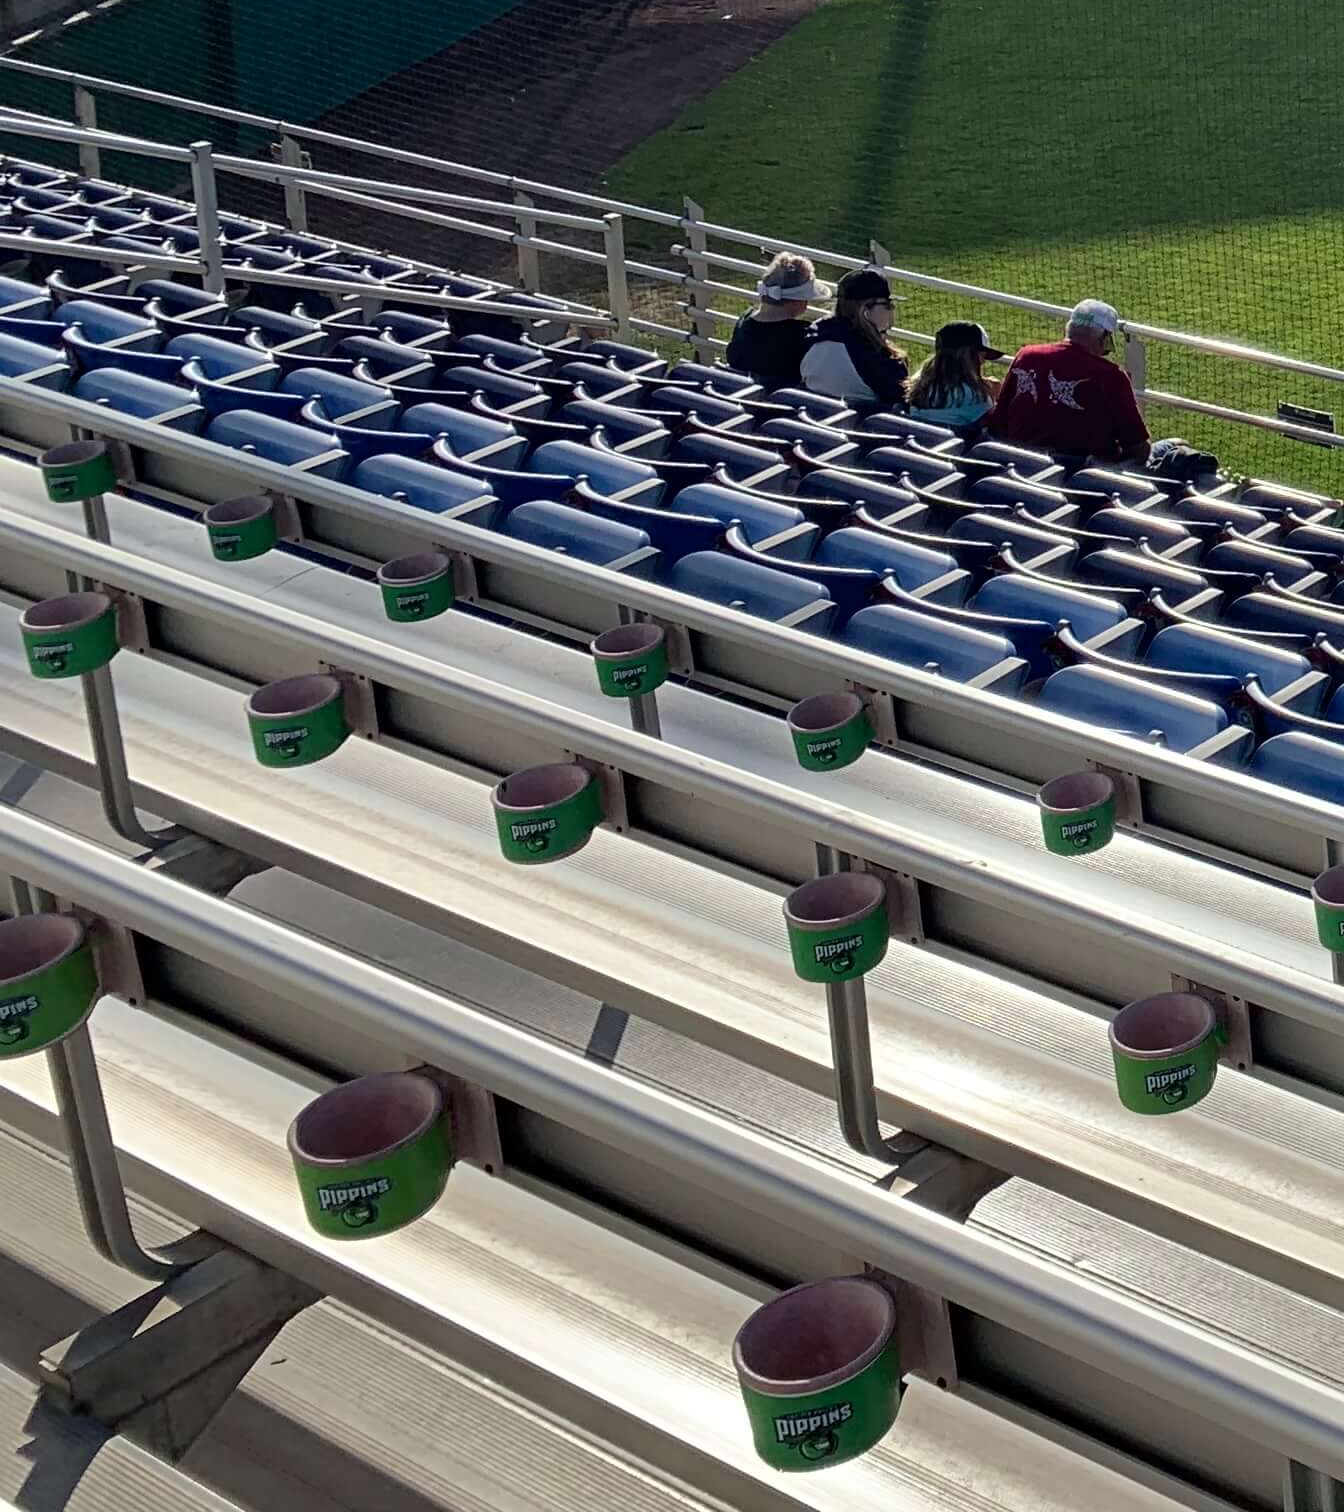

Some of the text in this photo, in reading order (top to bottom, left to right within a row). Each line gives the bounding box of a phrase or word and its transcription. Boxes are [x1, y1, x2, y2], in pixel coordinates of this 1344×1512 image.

[612, 665, 648, 683] PIPPINS
[263, 727, 309, 747] PIPPINS
[807, 738, 842, 755] PIPPINS
[511, 818, 556, 841] PIPPINS
[1061, 820, 1098, 839] PIPPINS
[815, 935, 863, 962] PIPPINS
[1146, 1064, 1196, 1092] PIPPINS
[318, 1178, 391, 1209] PIPPINS
[775, 1403, 852, 1441] PIPPINS
